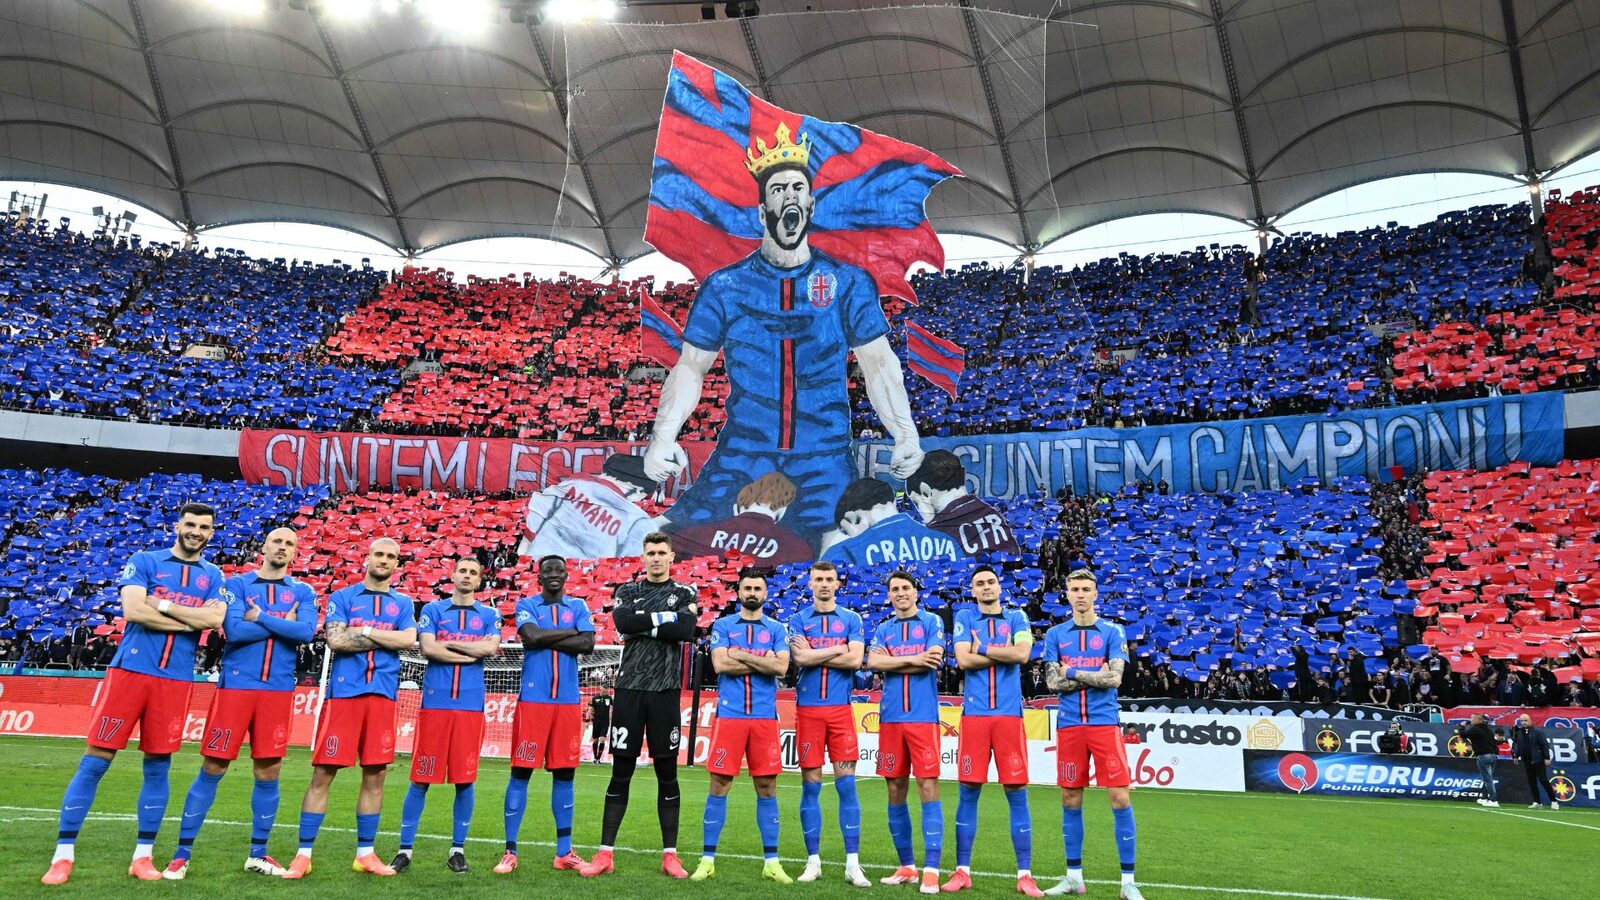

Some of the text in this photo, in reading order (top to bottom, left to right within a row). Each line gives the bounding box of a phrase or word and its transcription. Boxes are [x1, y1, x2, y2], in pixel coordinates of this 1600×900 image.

[263, 432, 470, 497] SUNTEM
[952, 434, 1174, 500] SUNTEM
[565, 485, 622, 537] DINAMO
[710, 530, 779, 558] RAPID
[958, 513, 1008, 554] CFR
[865, 535, 957, 566] CRAIOVA
[98, 716, 124, 741] 17
[207, 727, 232, 752] 21
[1159, 718, 1242, 747] tosto
[326, 735, 339, 758] 9
[515, 740, 537, 763] 42
[714, 747, 727, 769] 2
[414, 755, 436, 777] 31
[876, 750, 896, 773] 33
[962, 755, 972, 776] 8
[1059, 761, 1077, 783] 10
[1324, 763, 1436, 788] CEDRU
[1321, 783, 1406, 795] Publicitate
